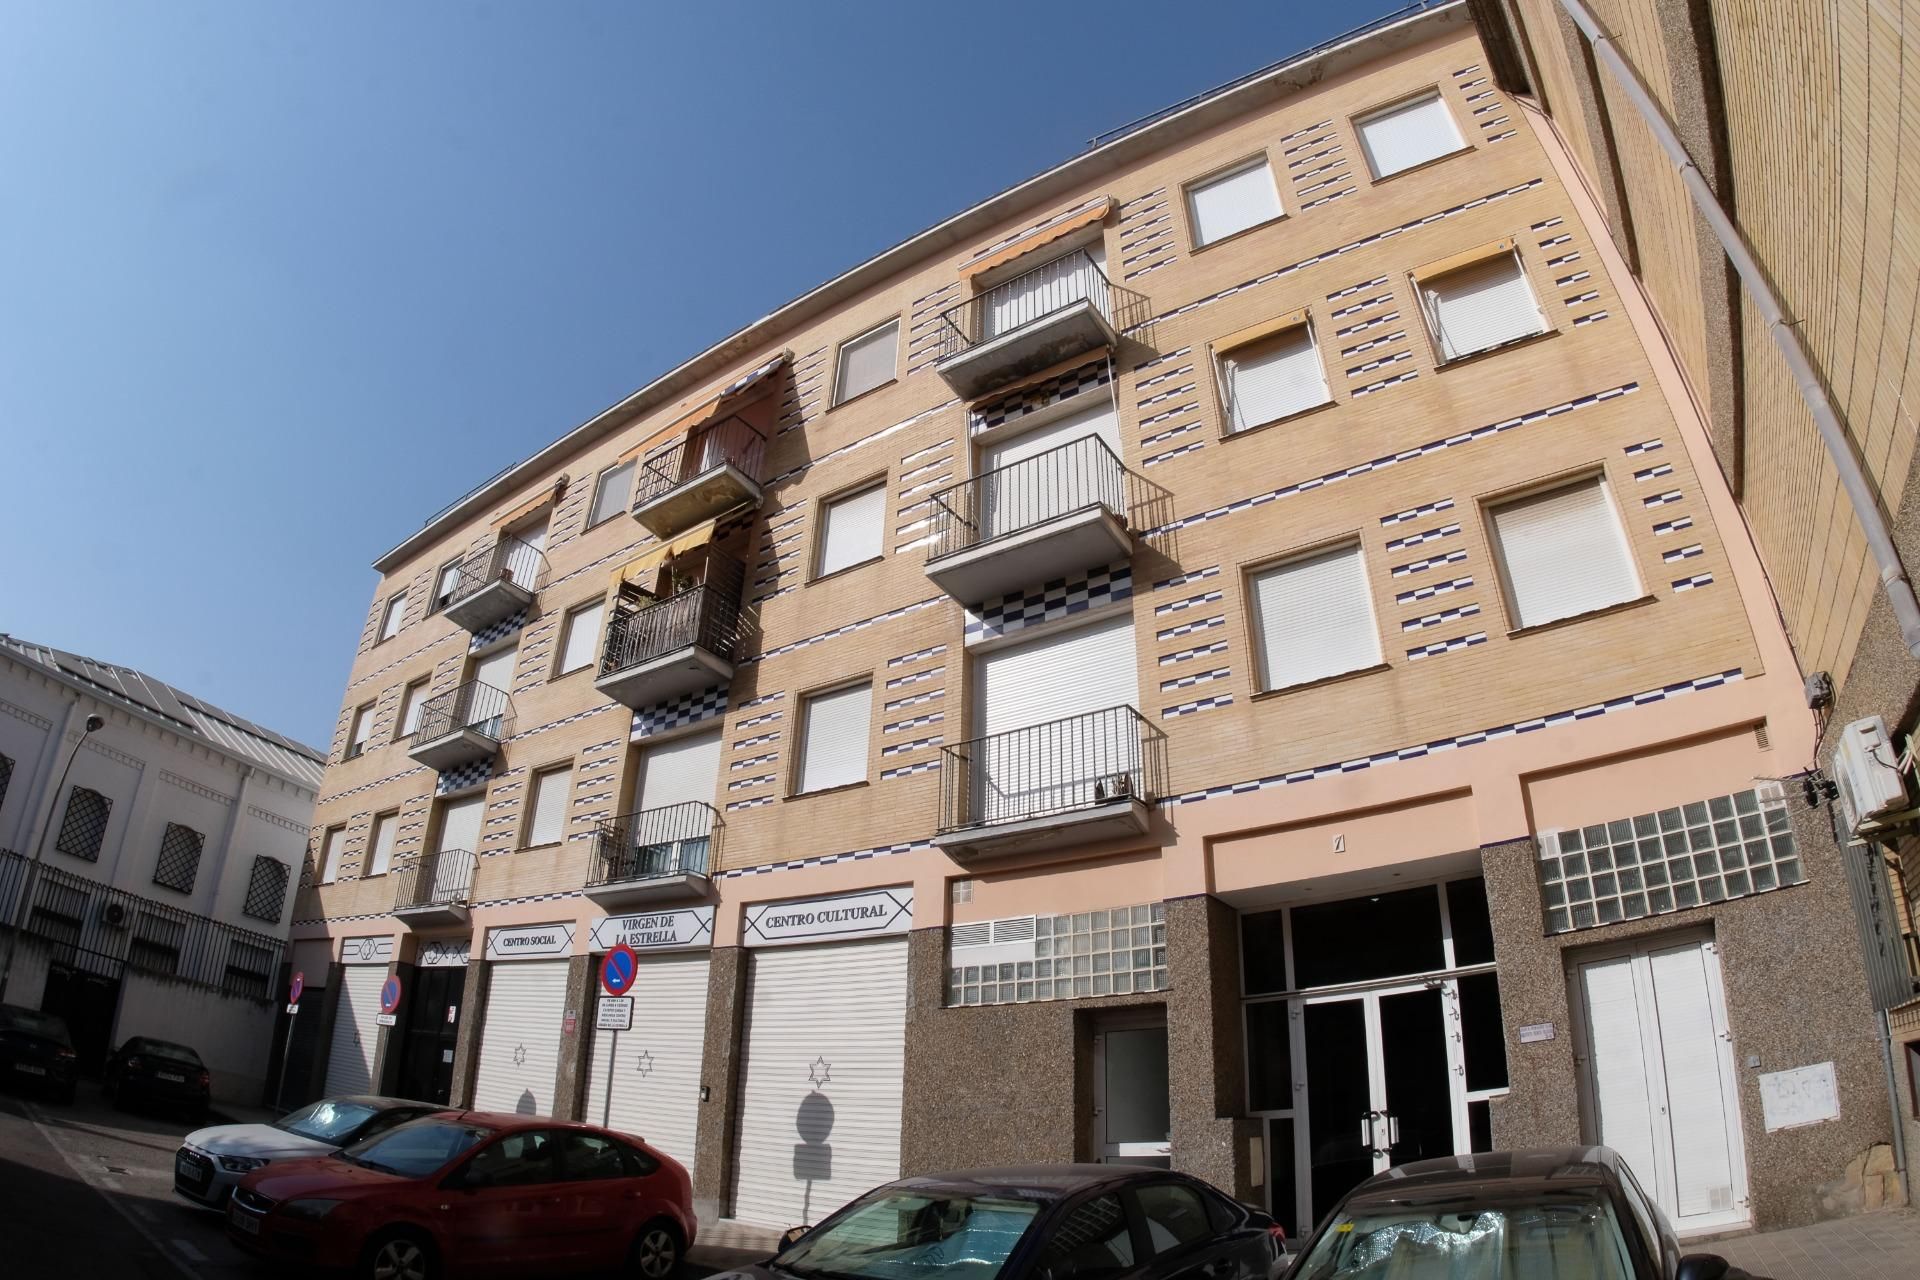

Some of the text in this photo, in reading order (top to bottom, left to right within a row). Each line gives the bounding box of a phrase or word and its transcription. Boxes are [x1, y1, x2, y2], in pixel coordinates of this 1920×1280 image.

[622, 915, 675, 930] VIRGEN DE
[765, 904, 887, 928] CENTRO CULTURAL
[503, 935, 556, 947] CENTRO SOCIAL
[616, 930, 677, 945] LA ESTRELLA
